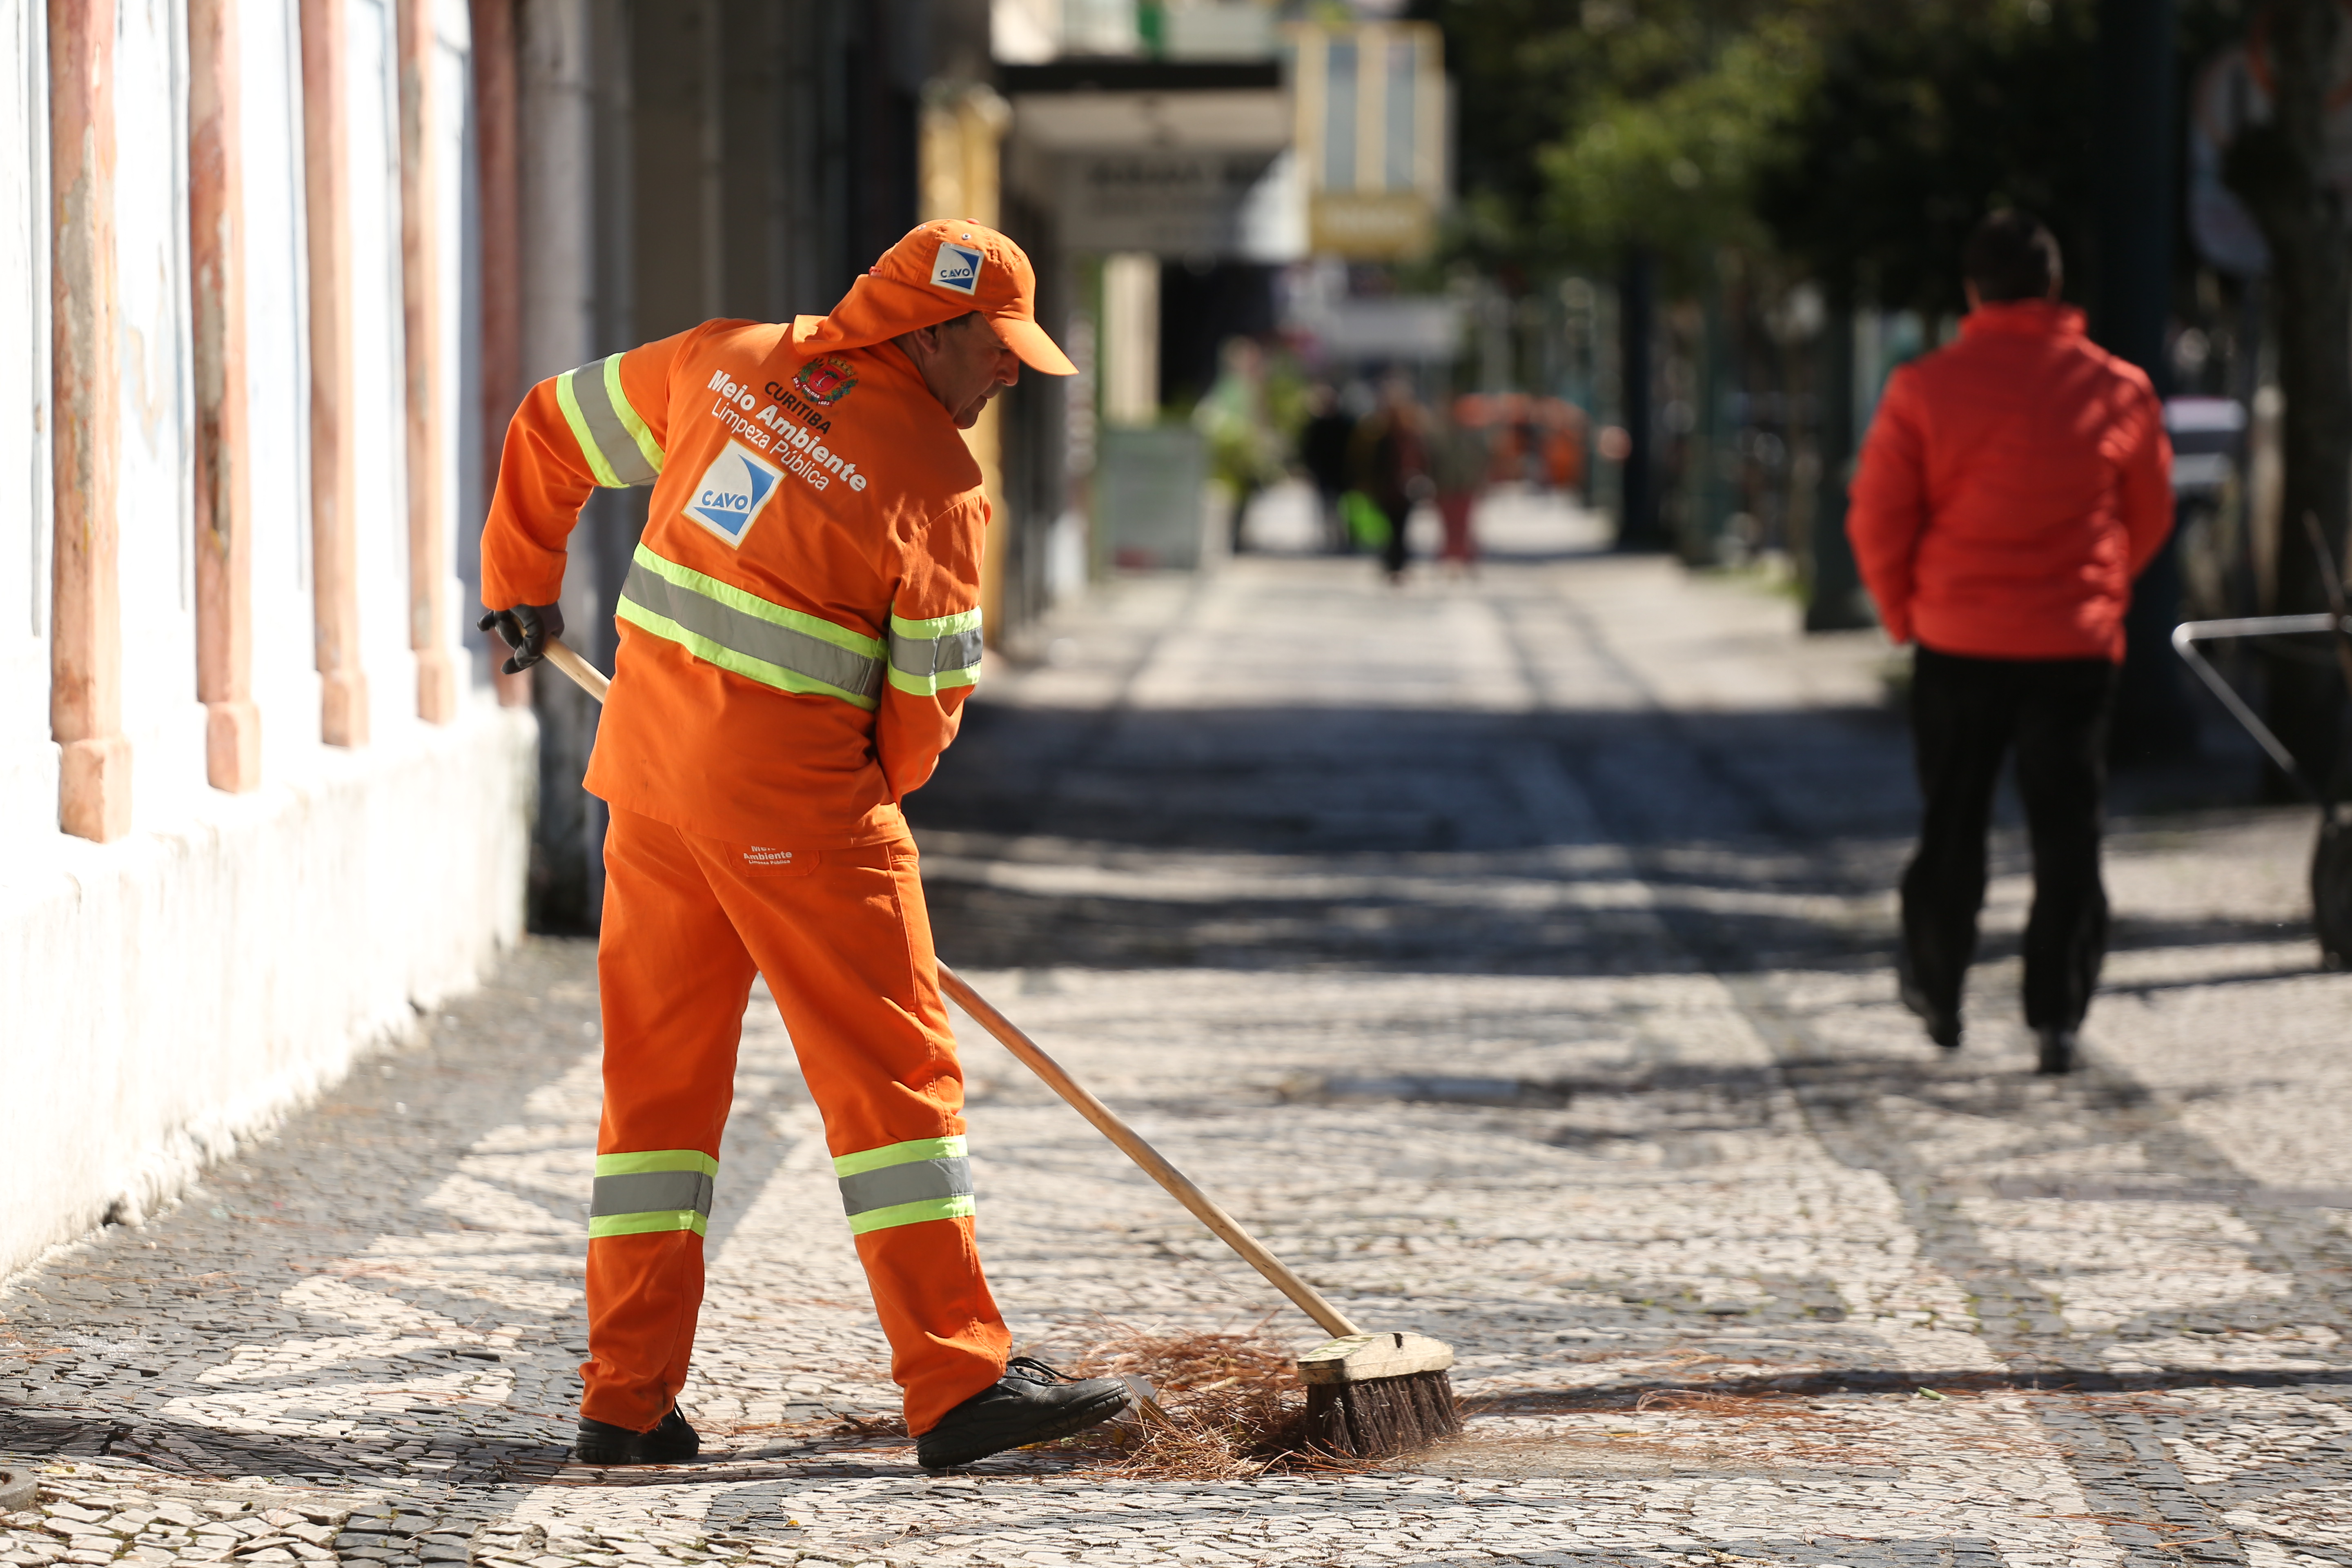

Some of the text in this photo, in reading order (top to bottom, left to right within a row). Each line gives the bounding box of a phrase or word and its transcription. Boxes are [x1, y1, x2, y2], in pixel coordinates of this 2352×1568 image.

[940, 268, 970, 278] CAVO
[764, 381, 831, 434] CURITIBA
[707, 369, 866, 491] Meio Ambiente
[711, 397, 830, 491] Limpeza Pública
[702, 490, 748, 510] CAVO
[743, 851, 792, 860] Ambiente
